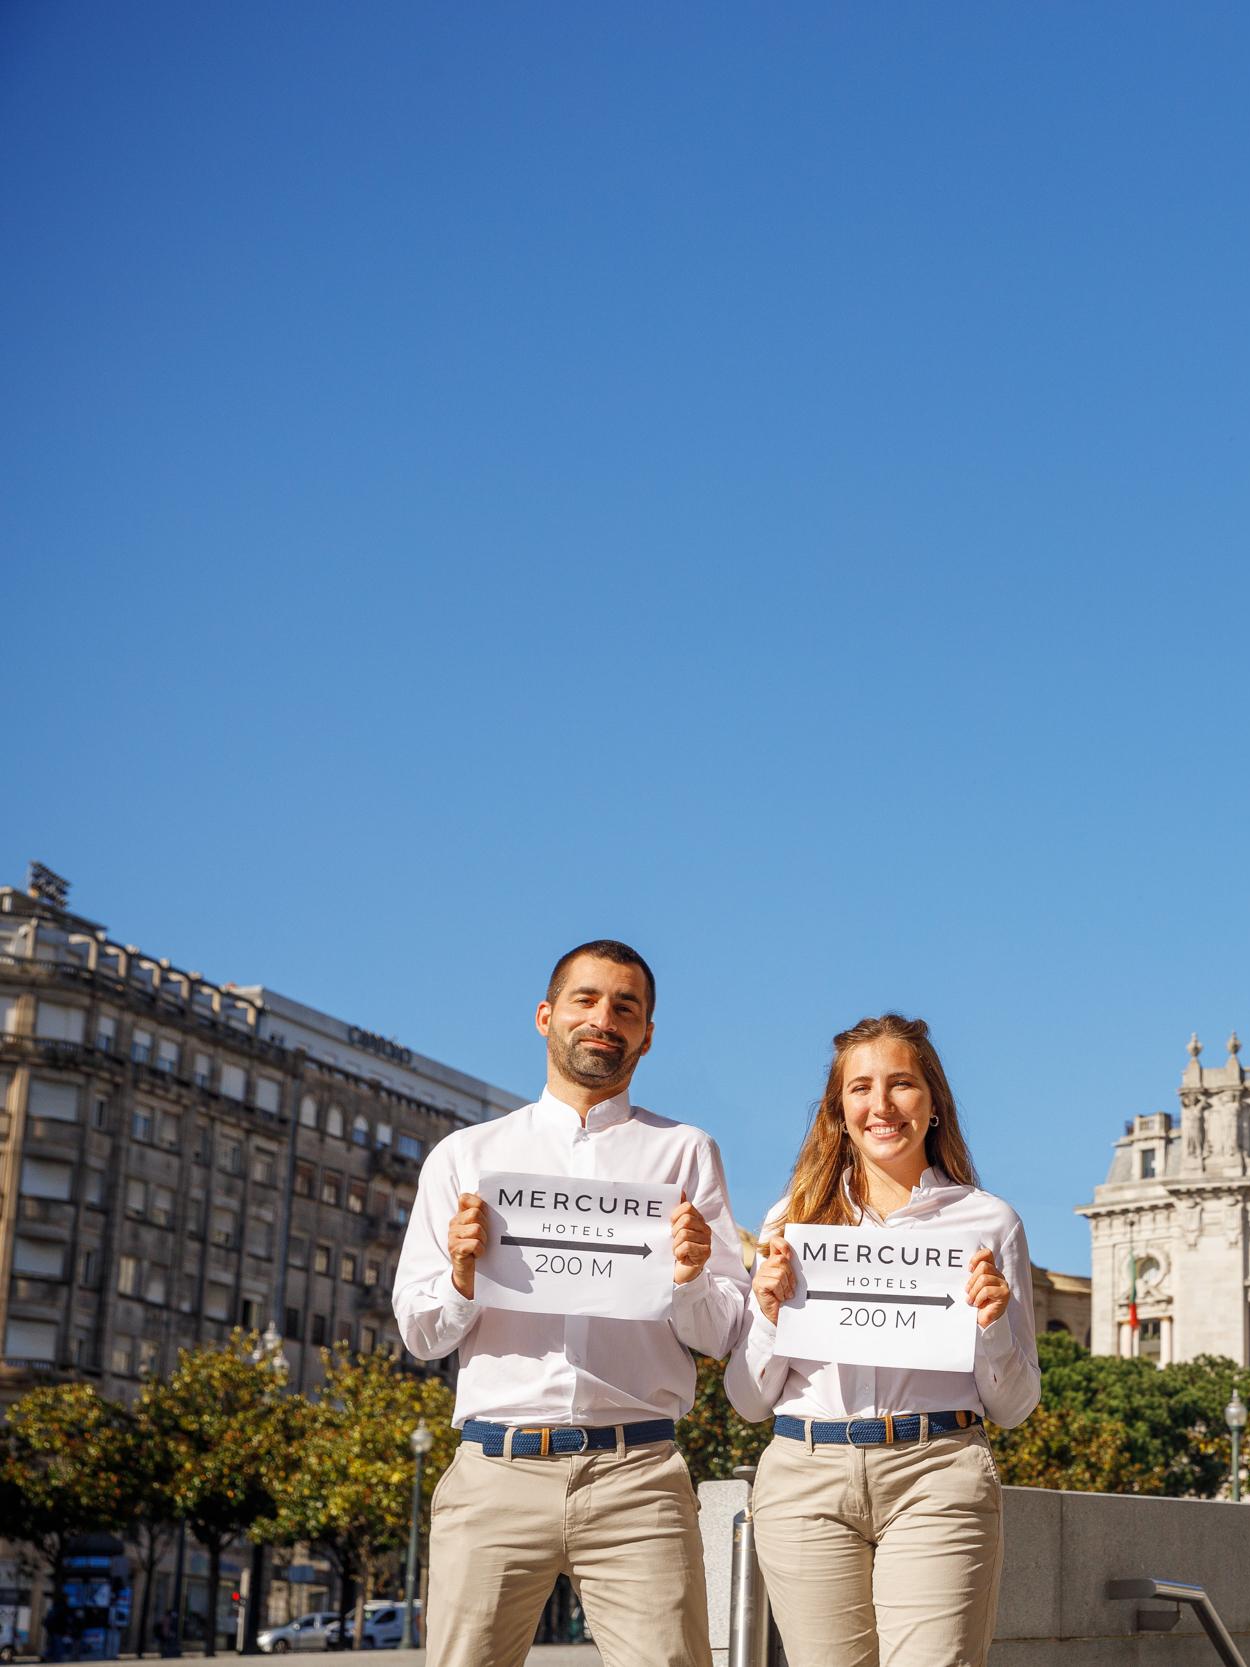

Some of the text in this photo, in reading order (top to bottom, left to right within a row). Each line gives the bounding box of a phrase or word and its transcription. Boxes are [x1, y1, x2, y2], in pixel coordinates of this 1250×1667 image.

[498, 1187, 663, 1219] MERCURE
[541, 1222, 615, 1239] HOTELS
[534, 1252, 613, 1279] 200 M
[802, 1241, 964, 1269] MERCURE
[846, 1276, 918, 1290] HOTELS
[838, 1306, 917, 1330] 200 M
